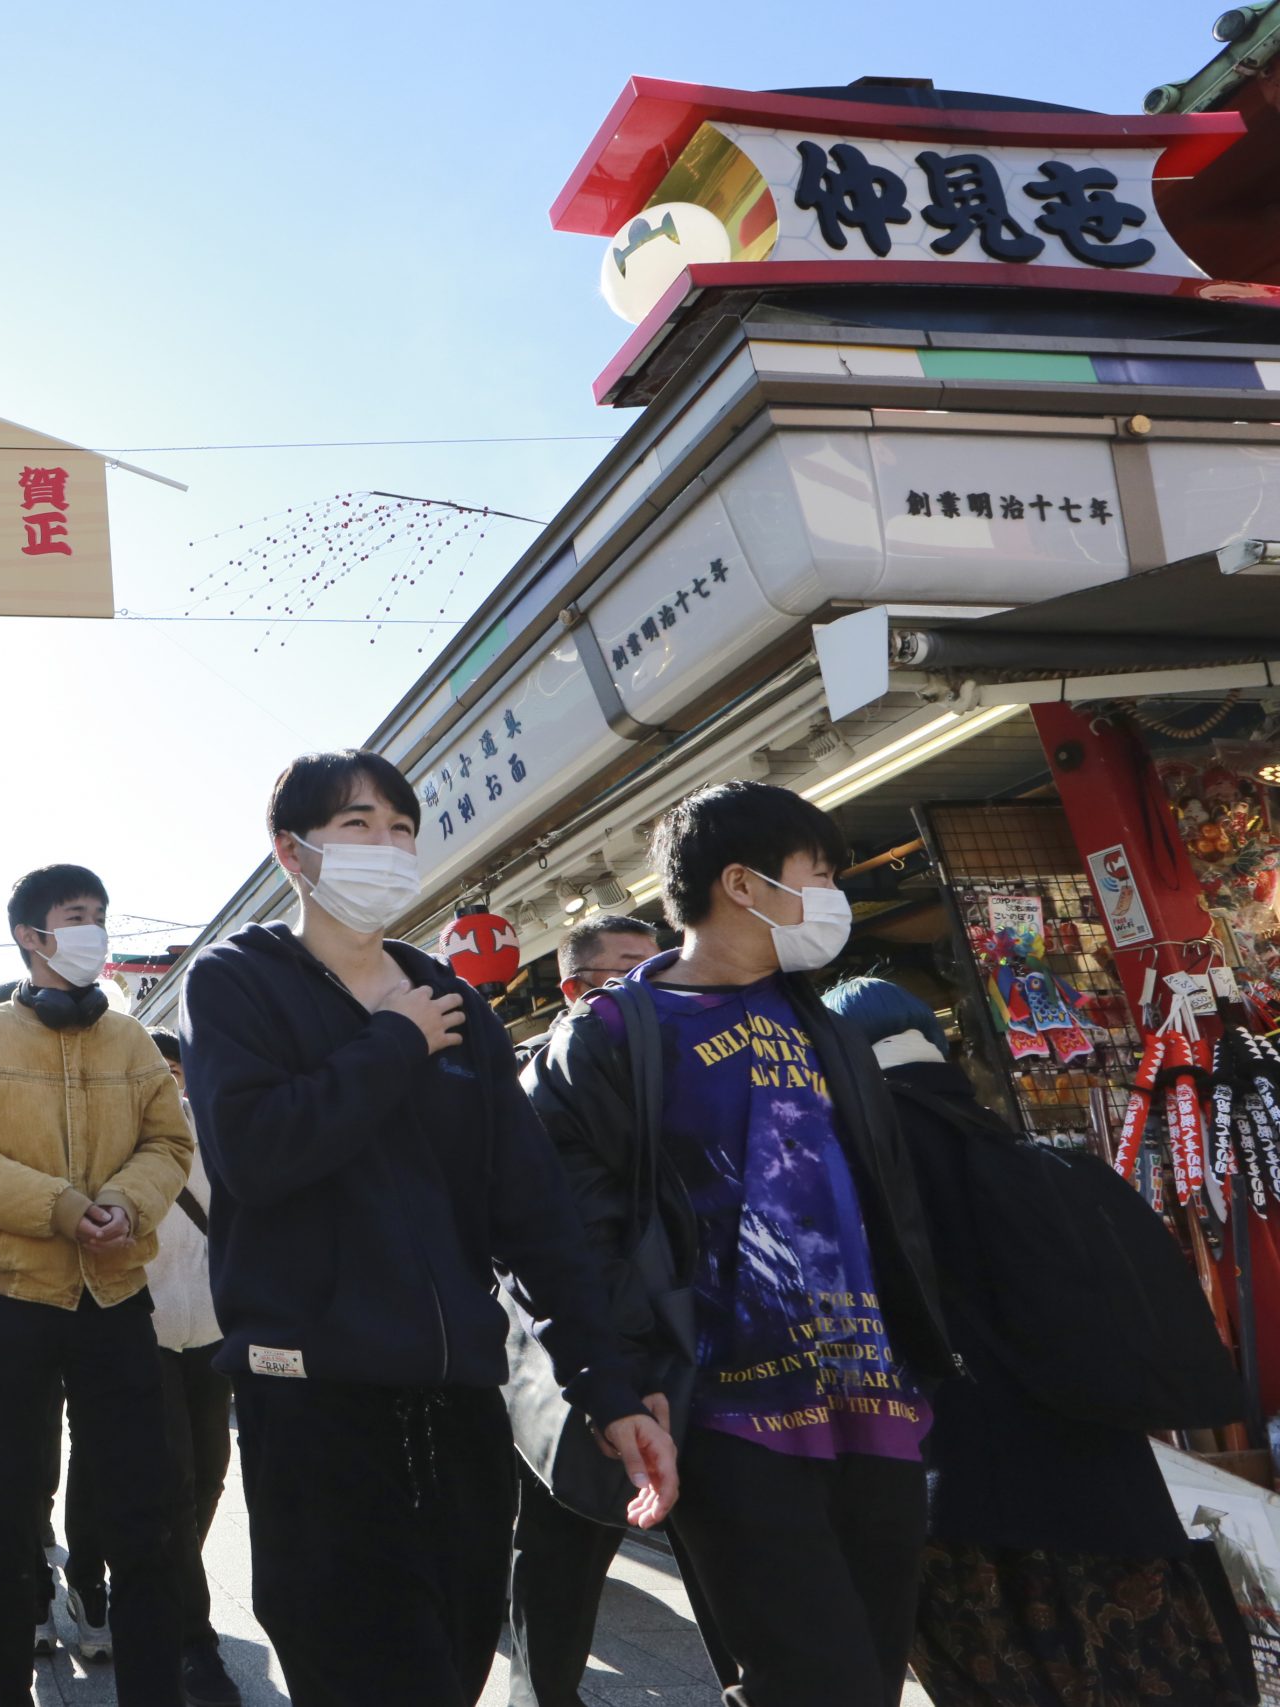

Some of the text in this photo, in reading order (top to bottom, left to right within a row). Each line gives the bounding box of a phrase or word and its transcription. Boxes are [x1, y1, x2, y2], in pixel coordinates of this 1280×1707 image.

[795, 140, 1156, 269] 仲見世
[18, 466, 72, 556] 賀正
[906, 489, 1113, 525] 創業明治十七年
[612, 558, 728, 671] 創業明治十七年
[993, 911, 1035, 922] こいのぼり
[764, 1407, 830, 1433] WORSH
